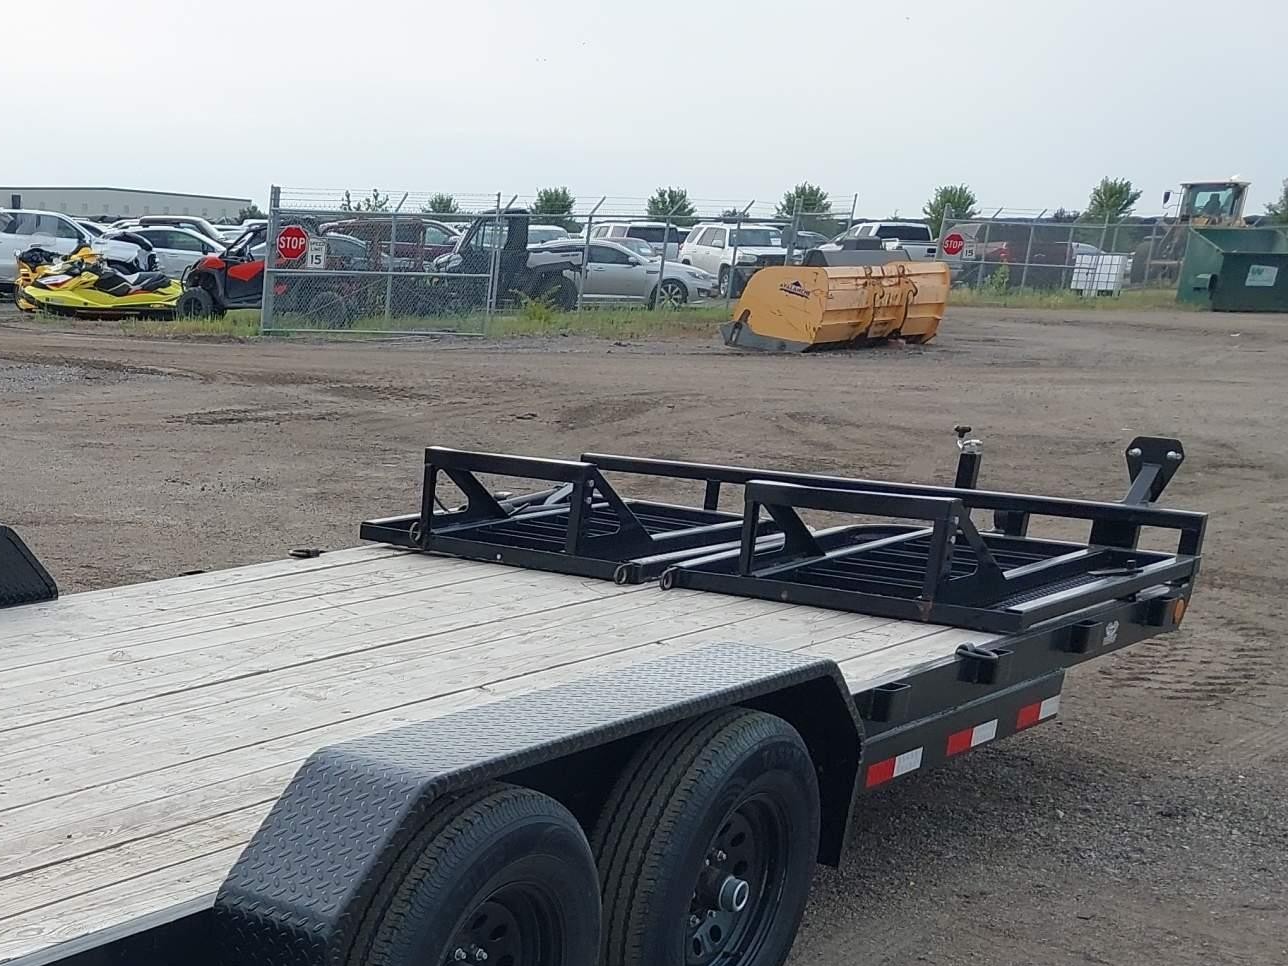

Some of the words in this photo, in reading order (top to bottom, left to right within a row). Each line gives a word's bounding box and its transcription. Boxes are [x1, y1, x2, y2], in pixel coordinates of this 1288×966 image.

[279, 236, 306, 249] STOP
[943, 240, 963, 249] STOP
[965, 249, 974, 257] 15
[310, 254, 322, 265] 15
